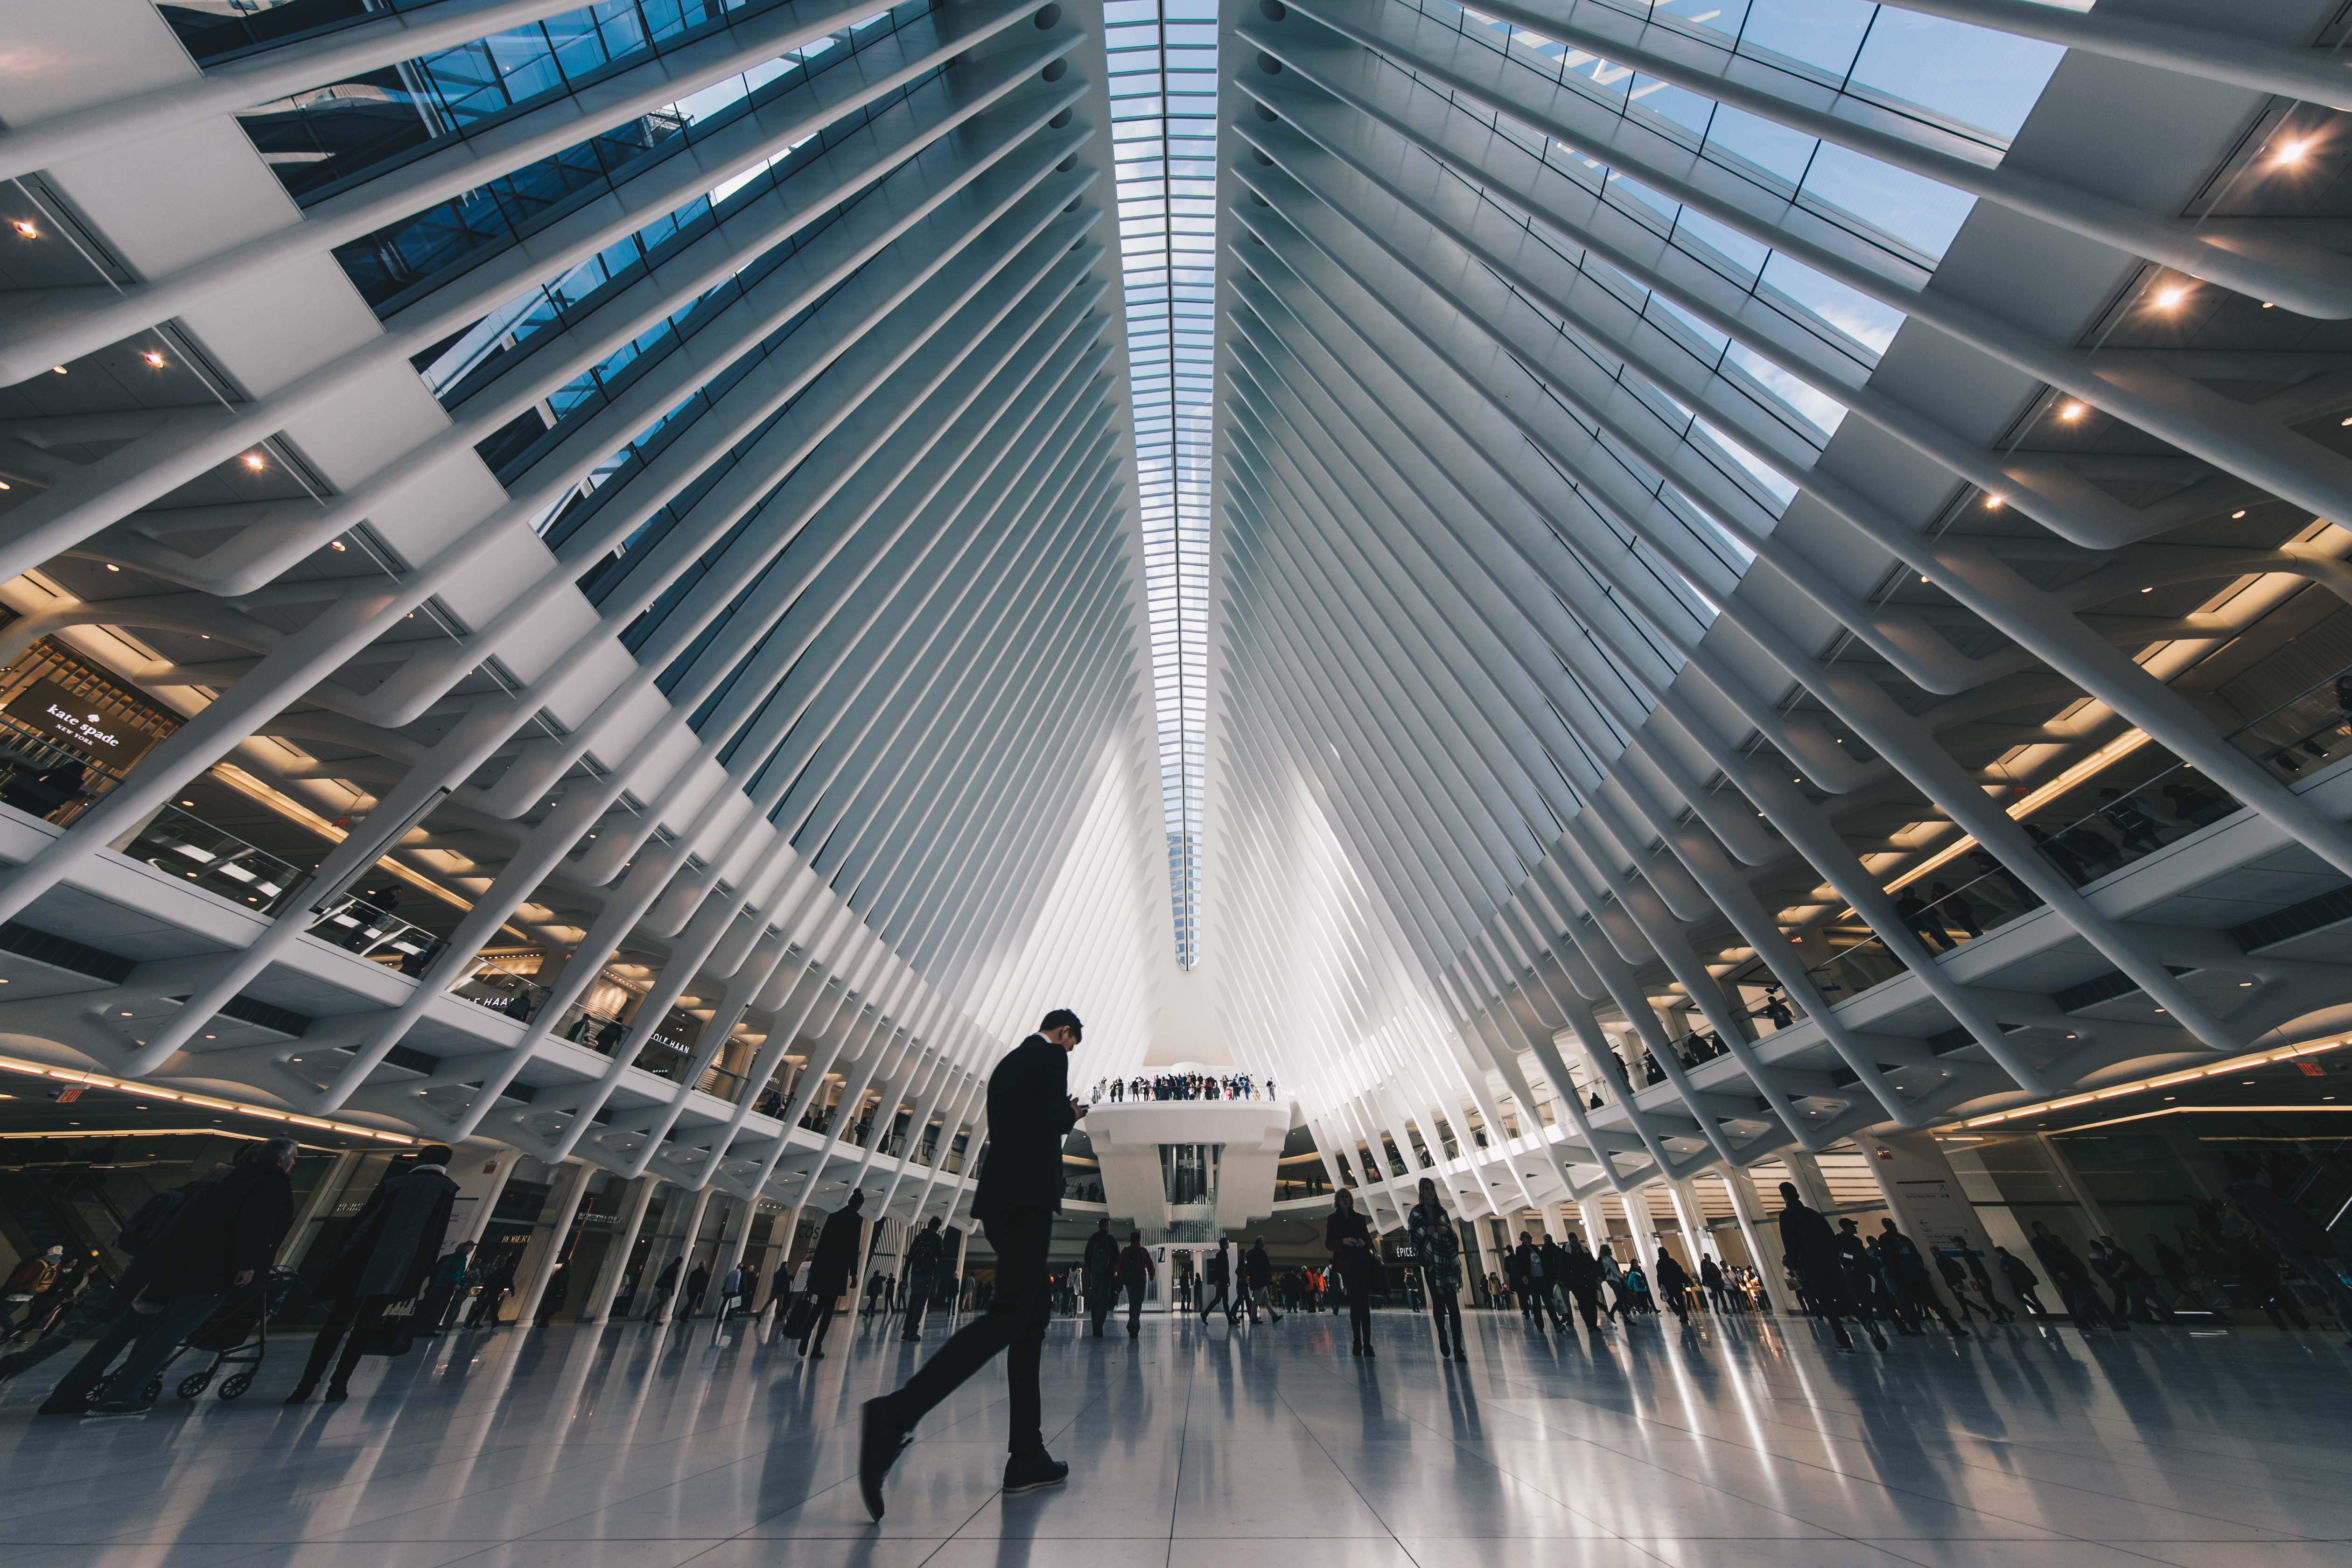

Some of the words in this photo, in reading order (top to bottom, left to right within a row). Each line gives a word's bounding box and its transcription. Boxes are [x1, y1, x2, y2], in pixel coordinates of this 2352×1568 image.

[47, 704, 79, 725] kate
[79, 724, 119, 747] spade
[55, 724, 74, 735] NEW
[74, 733, 94, 746] YORK
[669, 1040, 690, 1054] HAAN
[798, 1225, 820, 1239] COS
[1396, 1245, 1416, 1258] ÉPICE
